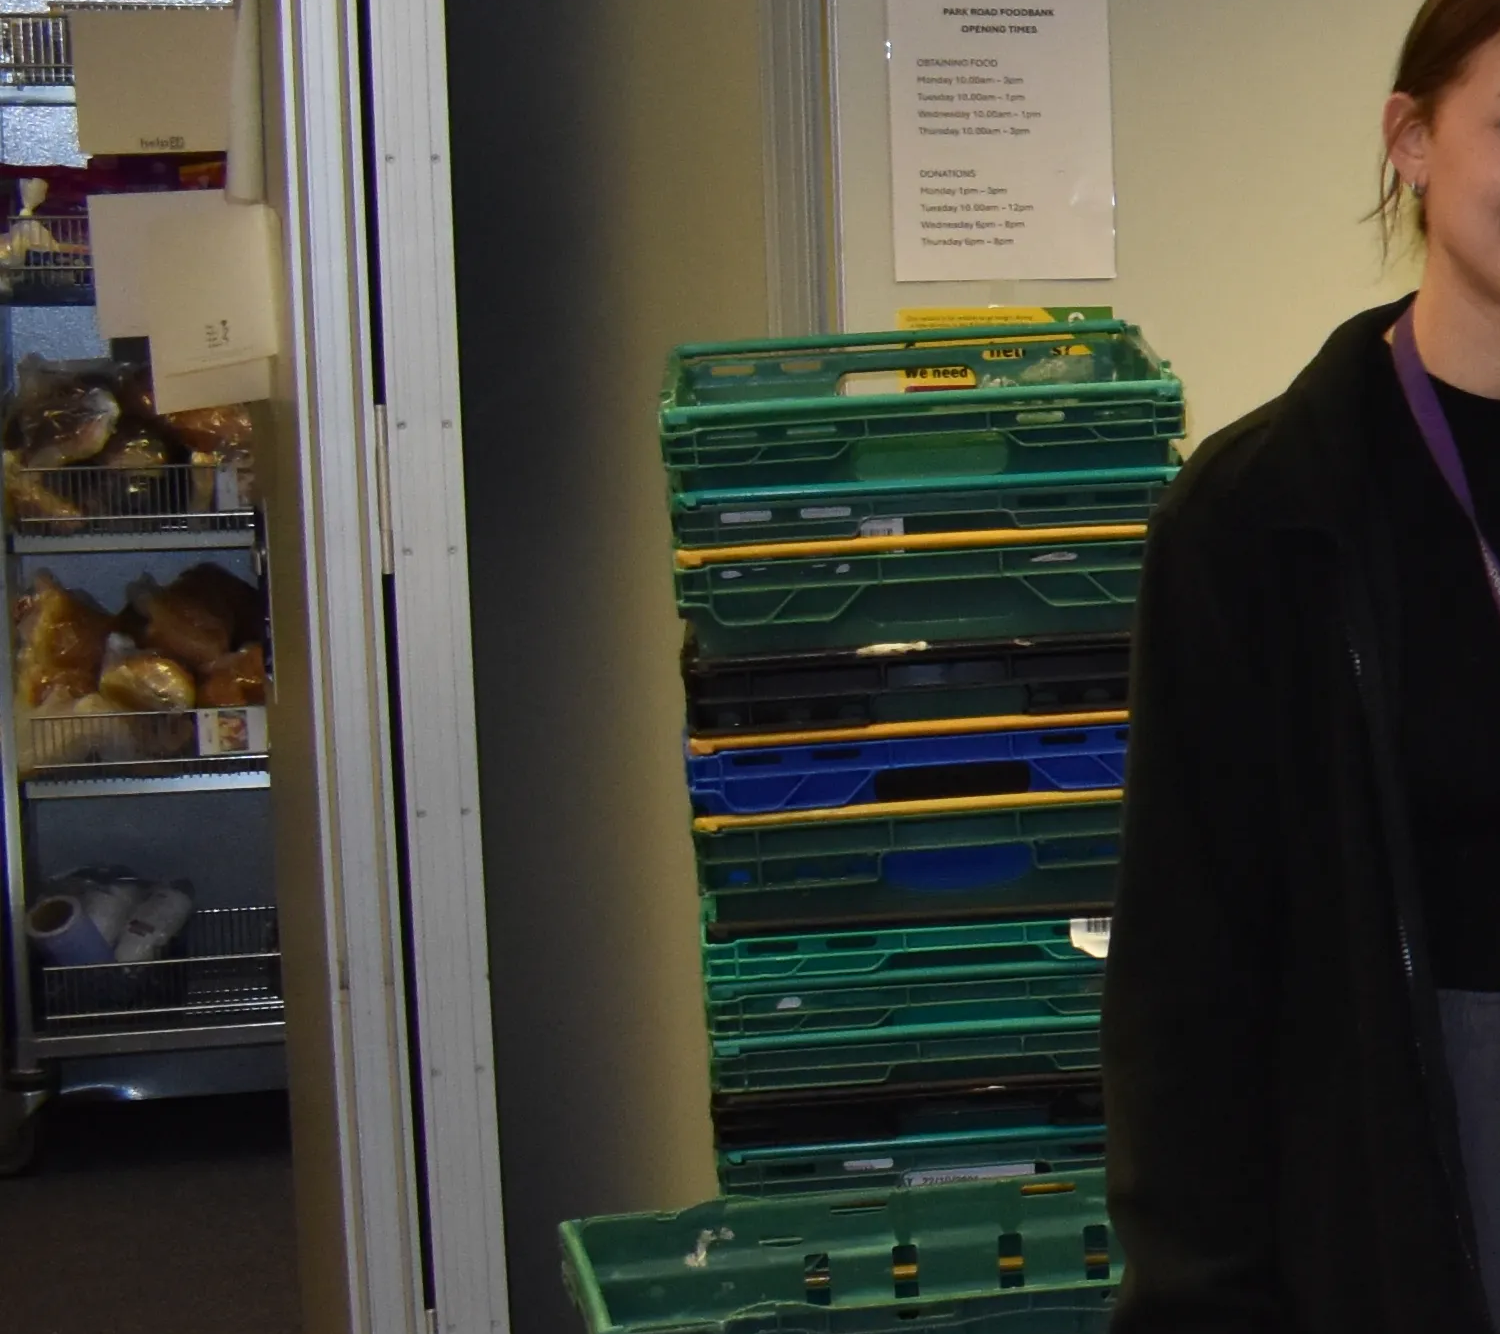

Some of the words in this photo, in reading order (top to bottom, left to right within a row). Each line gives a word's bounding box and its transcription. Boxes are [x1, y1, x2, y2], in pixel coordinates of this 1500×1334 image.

[943, 7, 969, 17] PARK
[970, 8, 998, 17] ROAD
[1000, 8, 1055, 18] FOODBANK
[961, 25, 1006, 35] OPENING
[1008, 25, 1039, 35] TIMES
